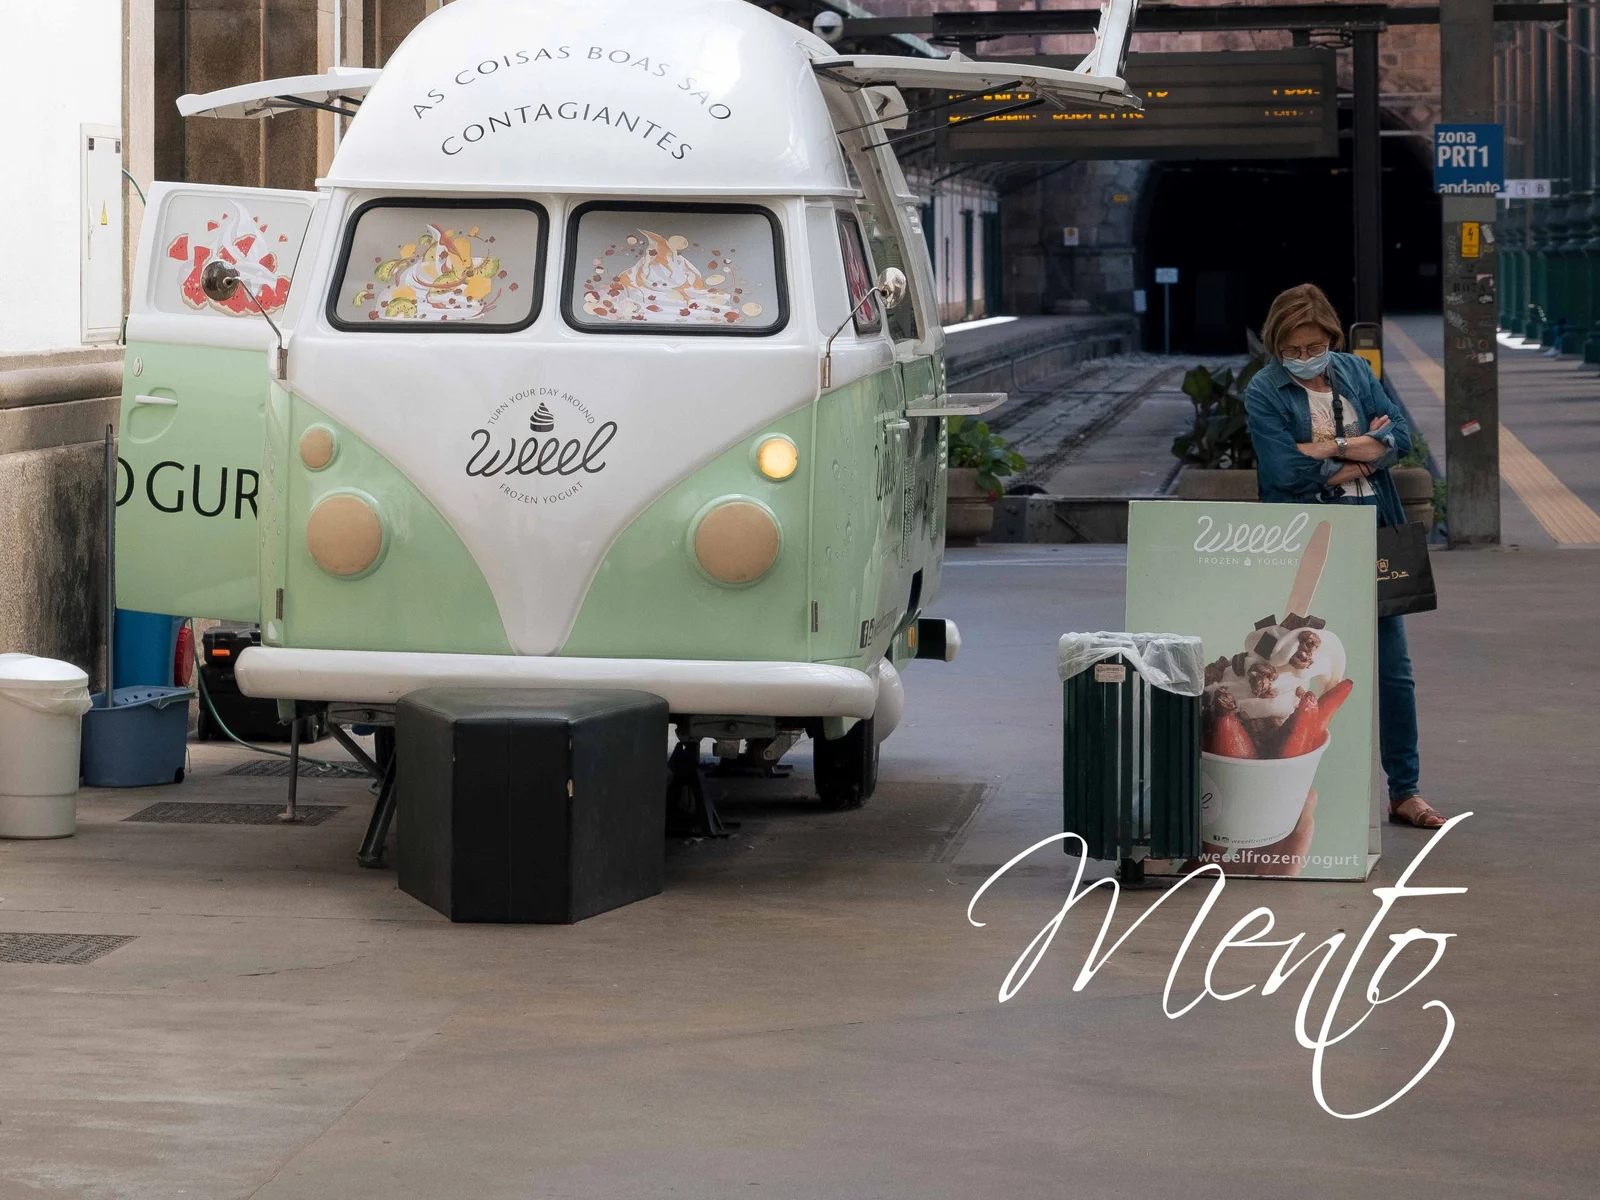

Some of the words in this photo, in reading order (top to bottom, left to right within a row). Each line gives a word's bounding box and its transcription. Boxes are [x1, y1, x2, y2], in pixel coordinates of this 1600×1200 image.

[413, 88, 445, 119] AS
[454, 45, 571, 86] COISAS
[586, 46, 670, 77] BOAS
[441, 102, 692, 160] CONTAGIANTES
[1437, 131, 1476, 144] zona
[1437, 145, 1489, 168] PRT1
[1438, 179, 1501, 194] andante
[487, 402, 509, 427] TURN
[509, 388, 536, 404] YOUR
[539, 387, 560, 396] DAY
[561, 392, 596, 425] AROUND
[498, 483, 538, 505] FROZEN
[542, 480, 584, 505] YOGURT
[1198, 556, 1240, 566] FROZEN
[1256, 556, 1301, 567] YOGURT
[1198, 850, 1360, 869] weeelfrozenyogurt
